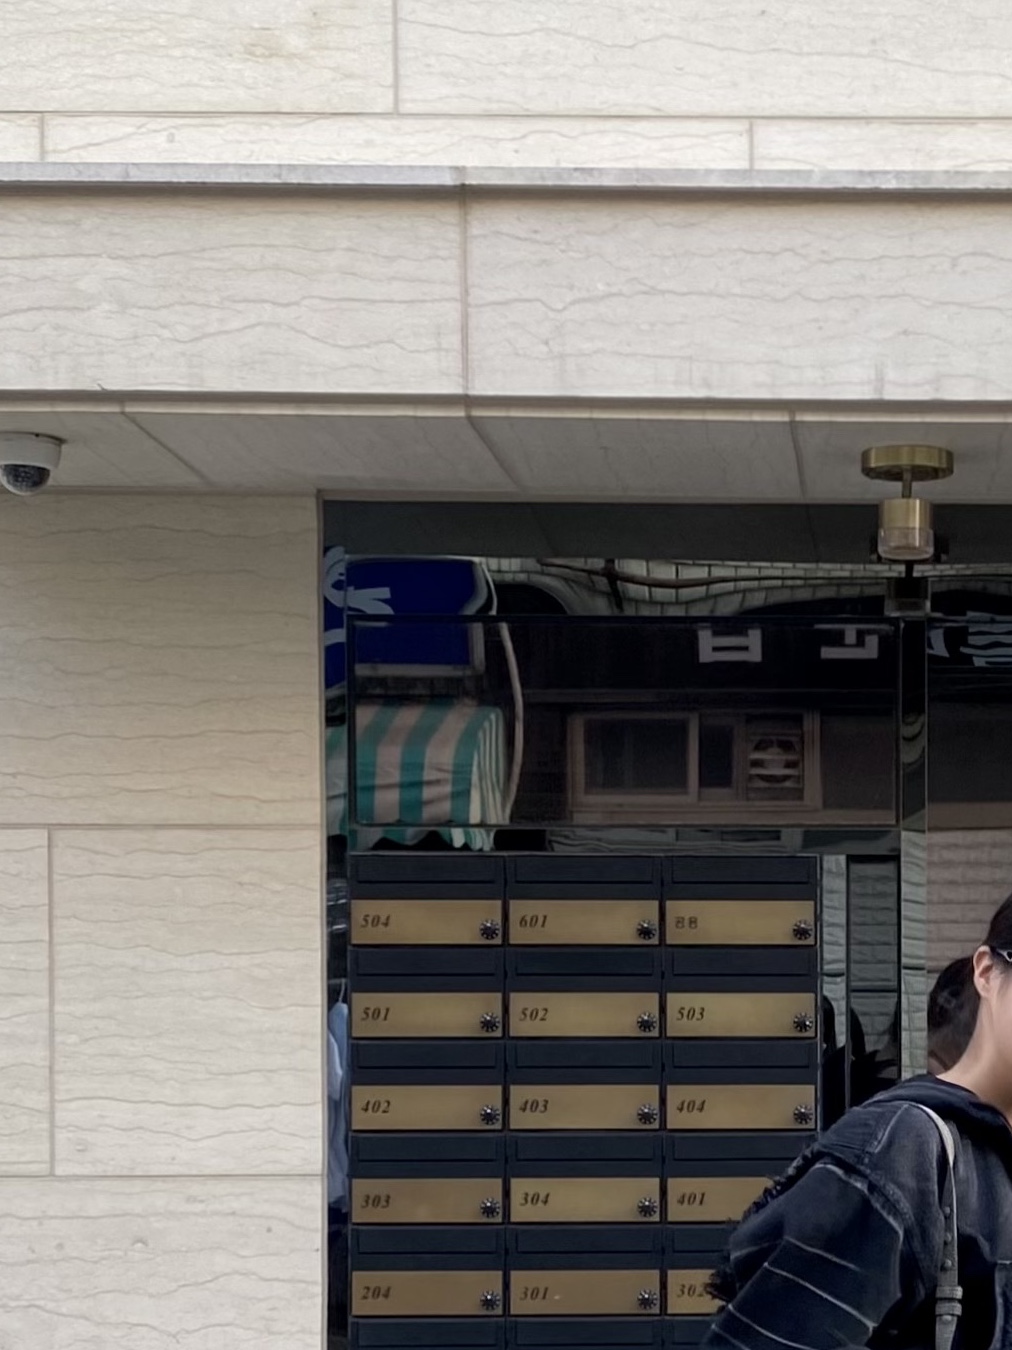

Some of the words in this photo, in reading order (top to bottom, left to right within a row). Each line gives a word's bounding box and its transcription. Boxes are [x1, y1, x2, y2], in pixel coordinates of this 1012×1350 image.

[360, 914, 391, 928] 504
[518, 914, 549, 928] 601
[360, 1007, 391, 1021] 501
[518, 1007, 549, 1021] 502
[676, 1007, 706, 1021] 503
[360, 1099, 391, 1113] 402
[518, 1099, 549, 1113] 403
[676, 1099, 706, 1113] 404
[360, 1193, 391, 1208] 303
[518, 1192, 549, 1206] 304
[676, 1192, 706, 1206] 401
[360, 1286, 391, 1300] 204
[518, 1286, 549, 1300] 301
